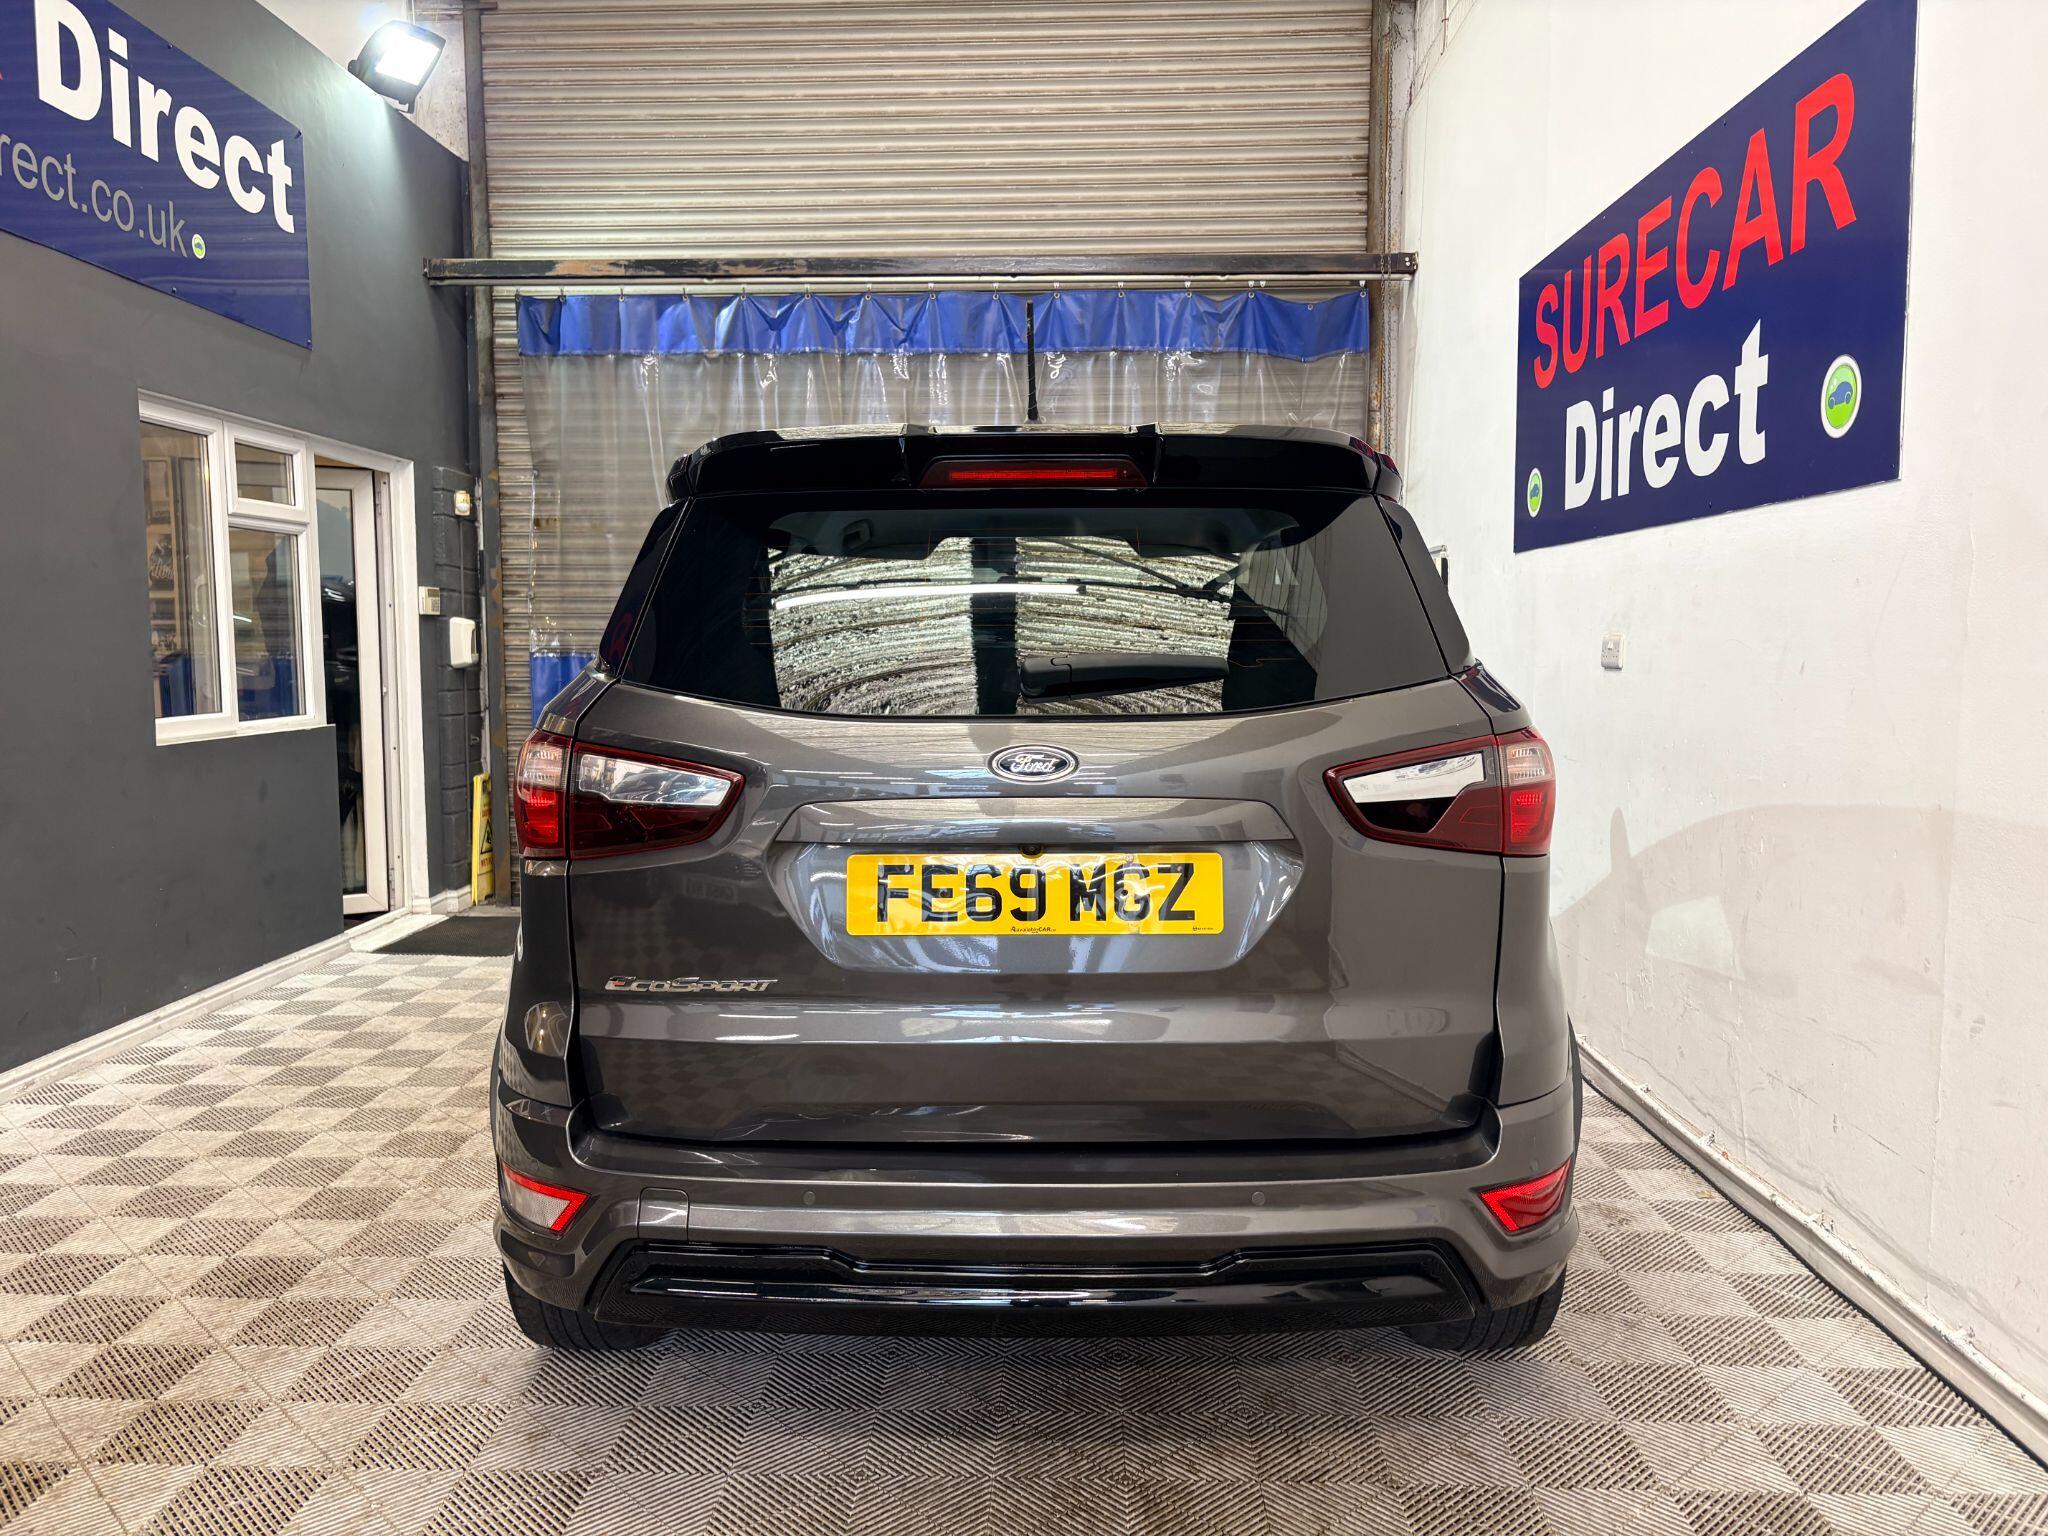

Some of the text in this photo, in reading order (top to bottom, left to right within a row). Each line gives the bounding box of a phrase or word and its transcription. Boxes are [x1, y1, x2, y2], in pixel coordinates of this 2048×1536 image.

[34, 0, 295, 233] Direct
[1533, 72, 1857, 389] SURECAR
[1564, 318, 1769, 511] Direct
[1008, 753, 1059, 773] Ford
[877, 863, 1195, 922] FE69 MGZ
